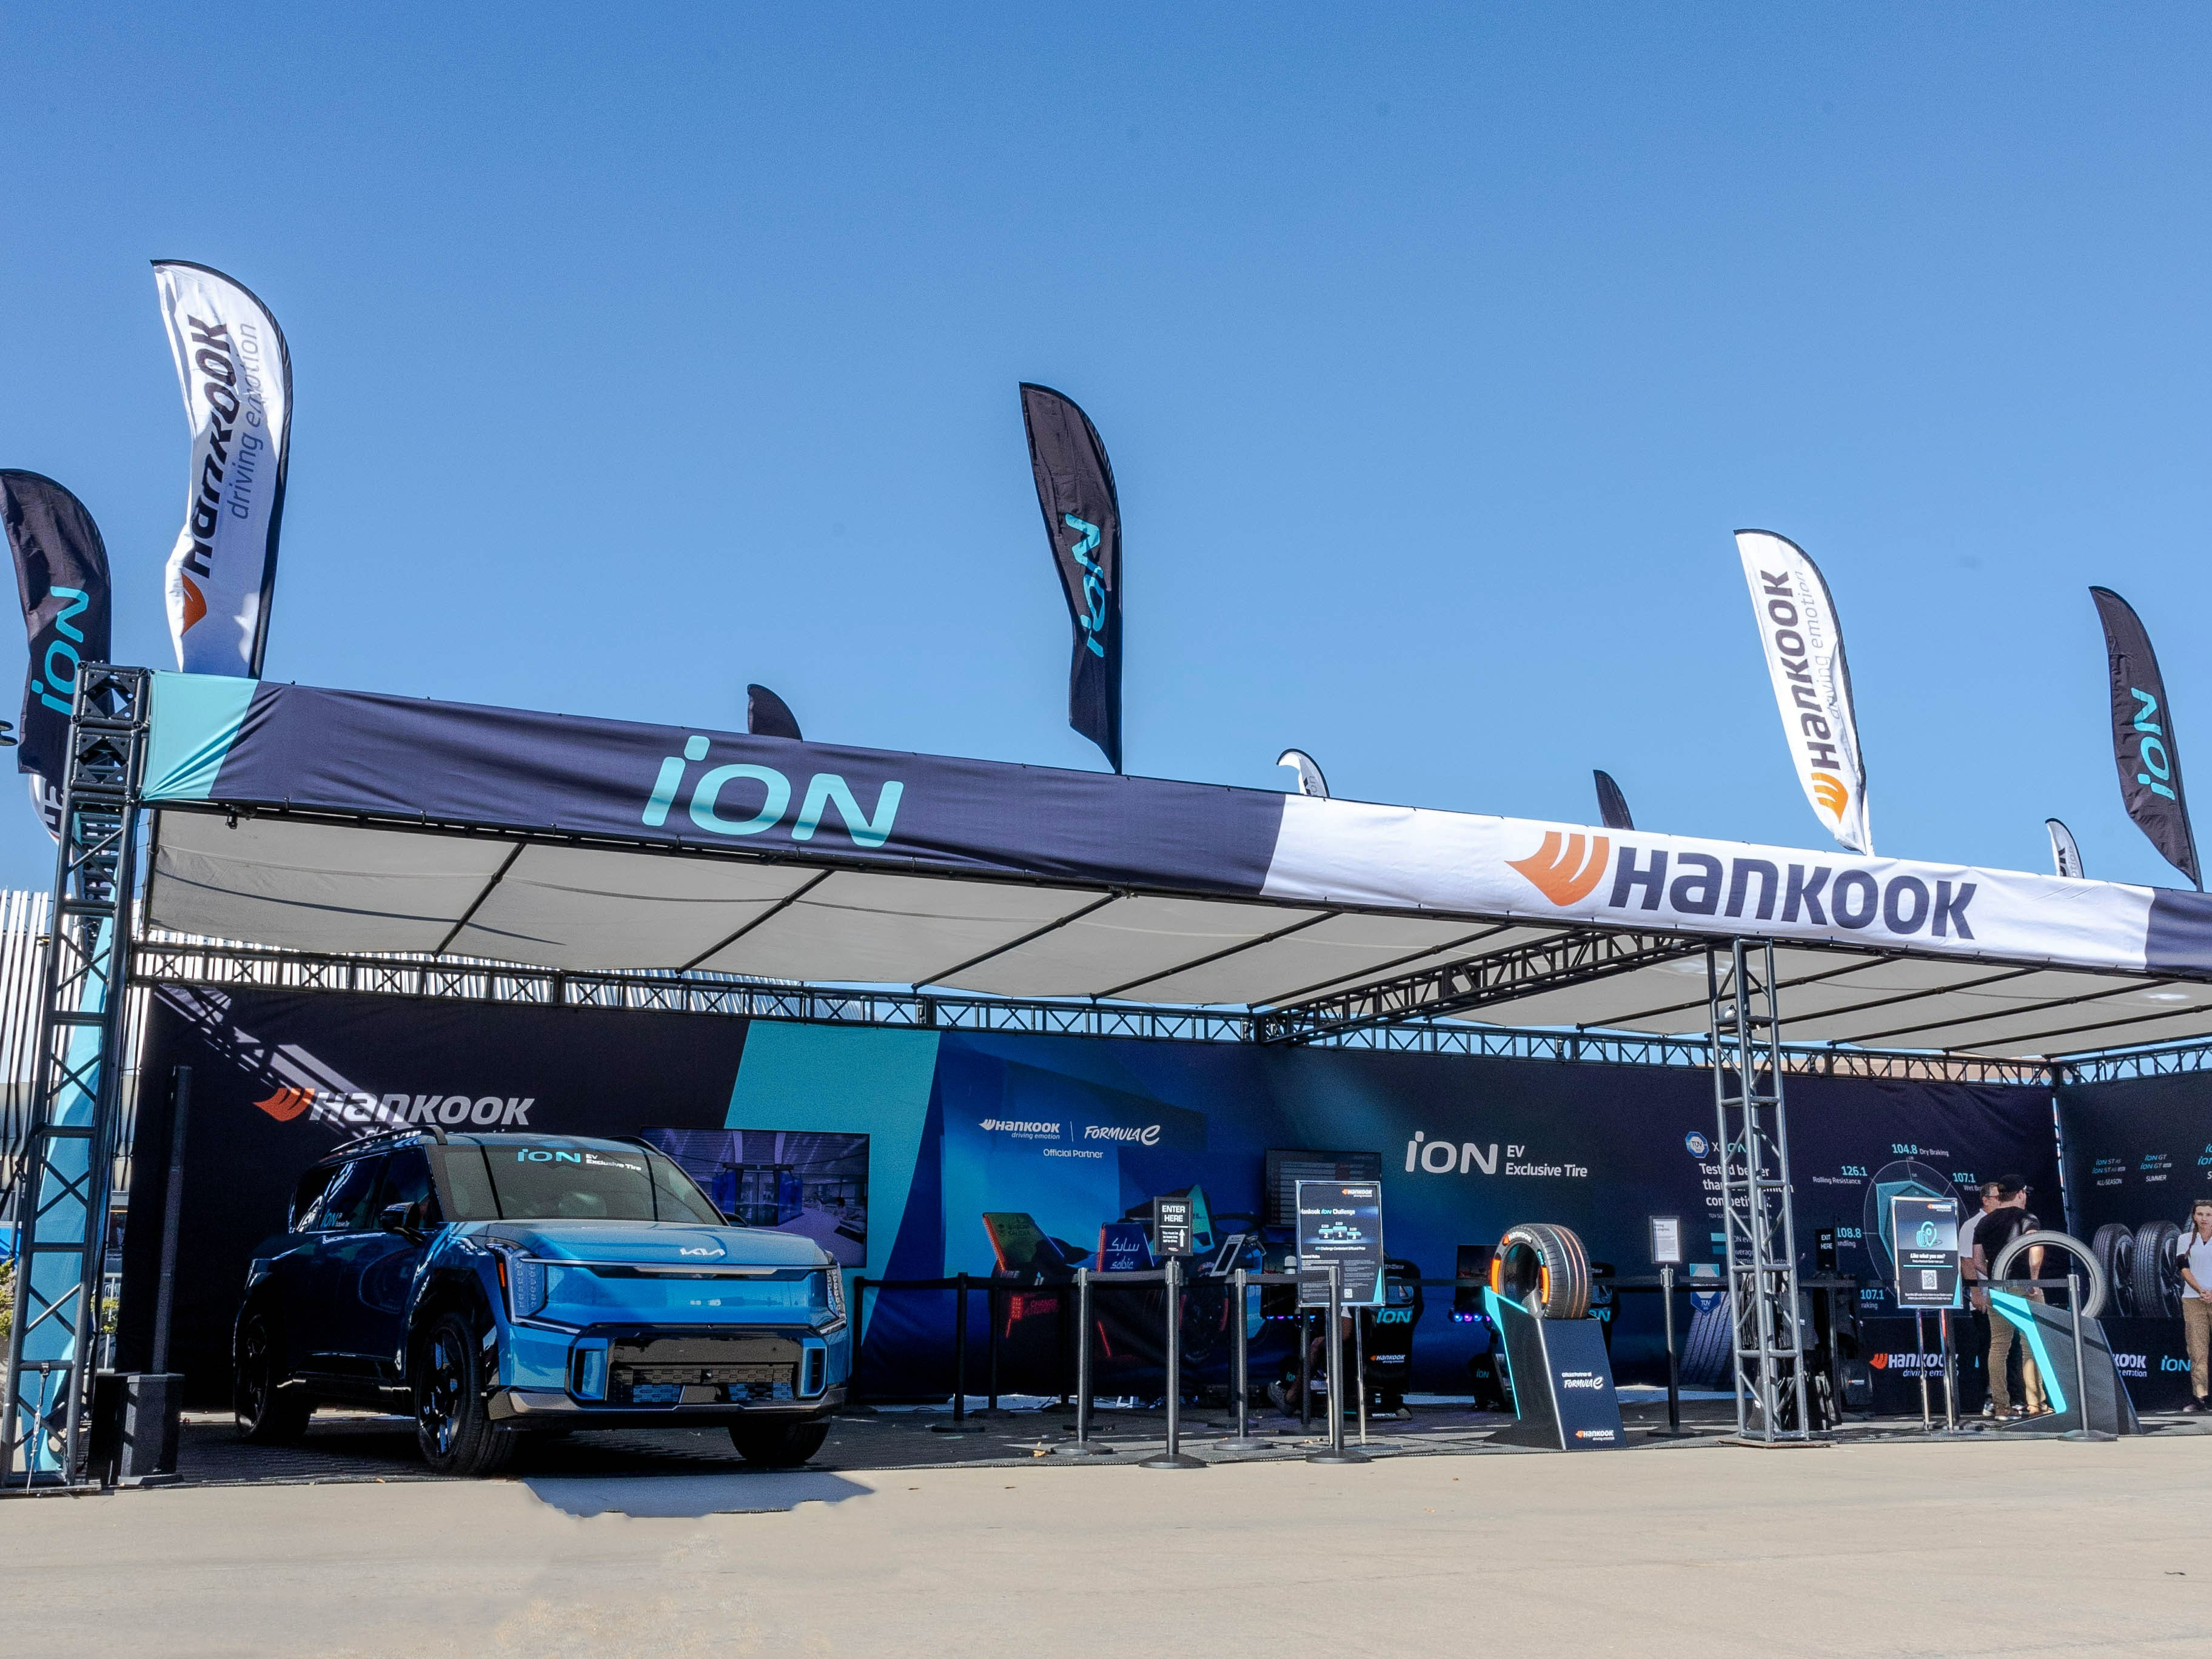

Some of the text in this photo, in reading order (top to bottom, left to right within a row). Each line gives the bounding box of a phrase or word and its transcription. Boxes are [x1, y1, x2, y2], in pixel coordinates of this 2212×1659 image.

[227, 432, 263, 519] driving
[1794, 570, 1823, 649] emotion
[642, 736, 903, 847] iON
[1043, 1148, 1104, 1159] Official Partner
[1507, 1145, 1525, 1158] EV
[1892, 1144, 1917, 1155] 104.8
[586, 1159, 625, 1168] Exclusive
[1506, 1162, 1587, 1177] Exclusive Tire
[1698, 1163, 1769, 1176] Testd beer
[1841, 1165, 1868, 1176] 126.1
[1952, 1173, 1976, 1183] 107.1
[1162, 1205, 1185, 1213] ENTER
[1110, 1256, 1134, 1269] sabic
[1860, 1289, 1884, 1300] 107.1
